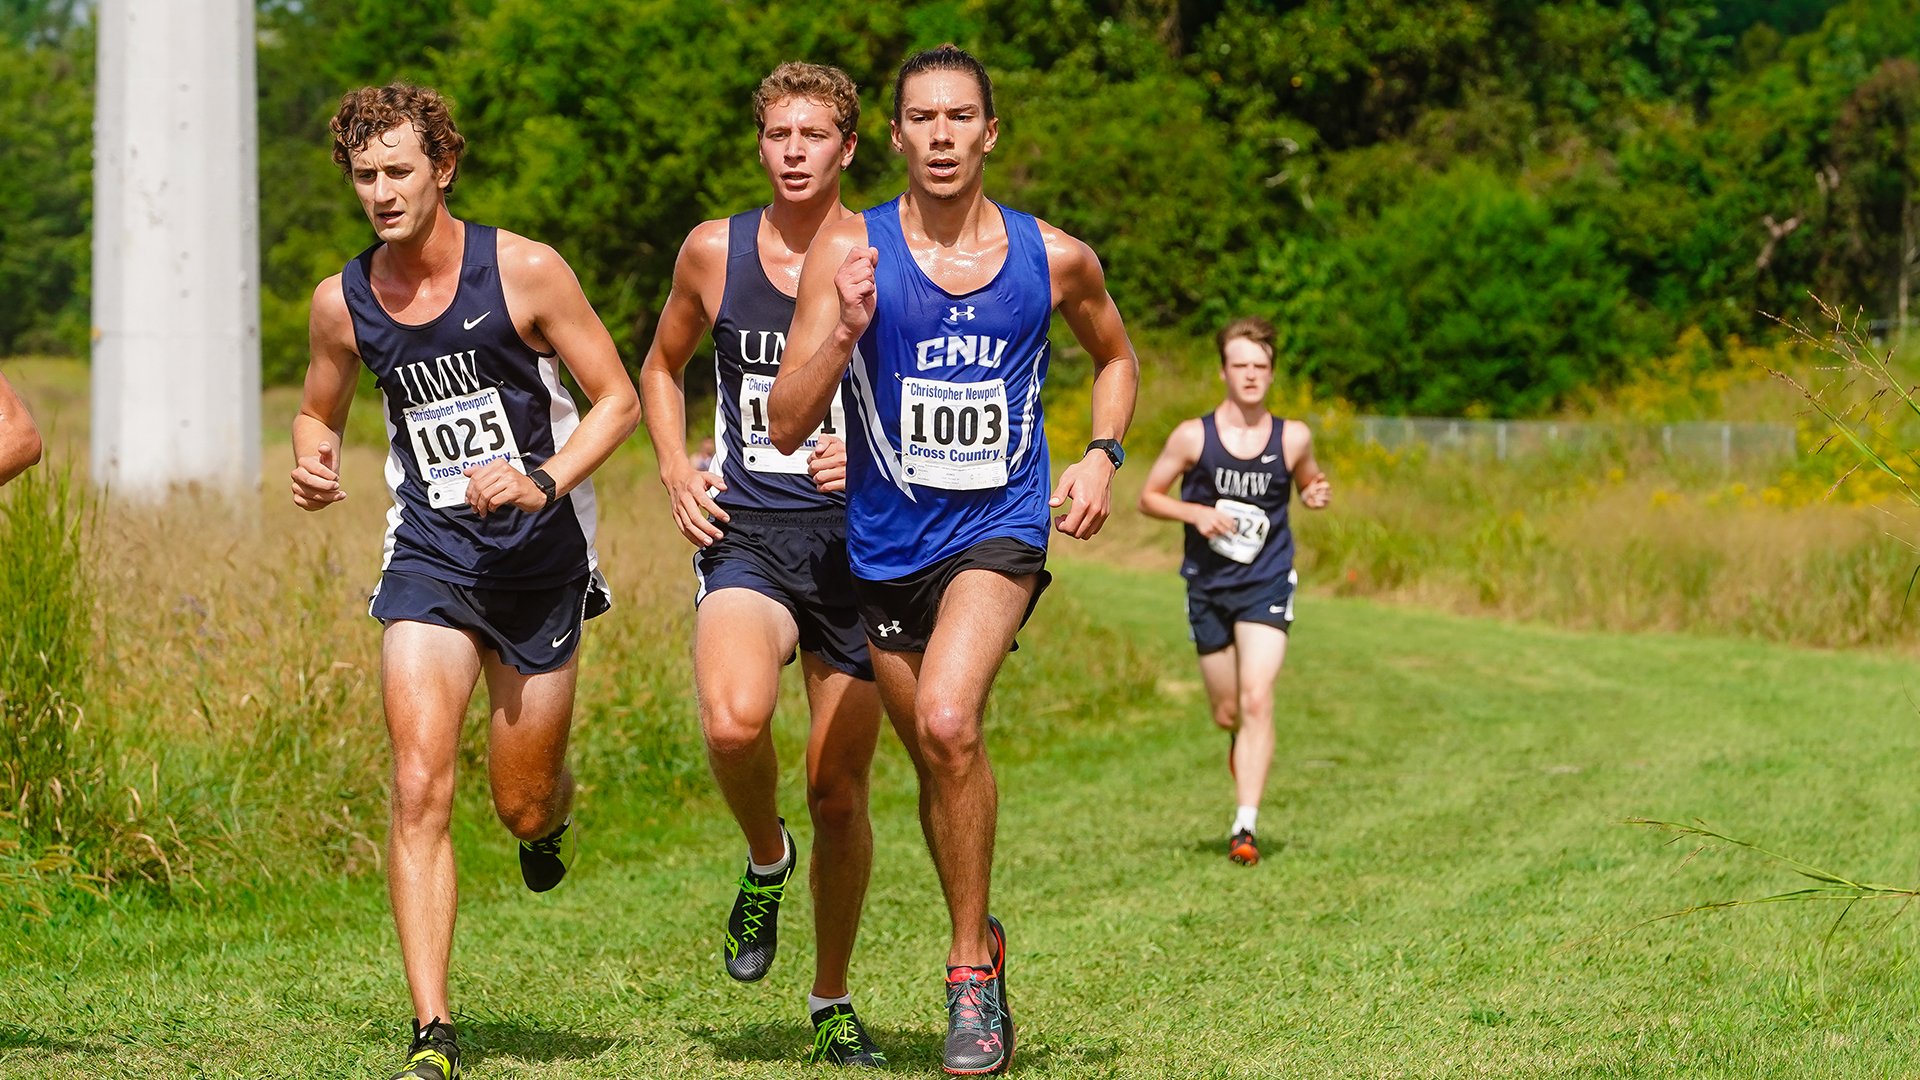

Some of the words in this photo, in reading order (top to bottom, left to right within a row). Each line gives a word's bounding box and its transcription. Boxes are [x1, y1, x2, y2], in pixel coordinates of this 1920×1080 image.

[915, 335, 1008, 371] CNU
[394, 350, 481, 406] UMW
[910, 382, 963, 402] Christopher
[965, 384, 1001, 402] Newport
[409, 403, 455, 423] Christopher
[455, 392, 494, 412] Newport
[749, 397, 836, 434] 11
[417, 410, 505, 465] 1025
[910, 403, 1002, 446] 1003
[909, 443, 946, 460] Cross
[949, 448, 1001, 462] Country
[429, 465, 462, 480] Cross
[1214, 467, 1273, 497] UMW
